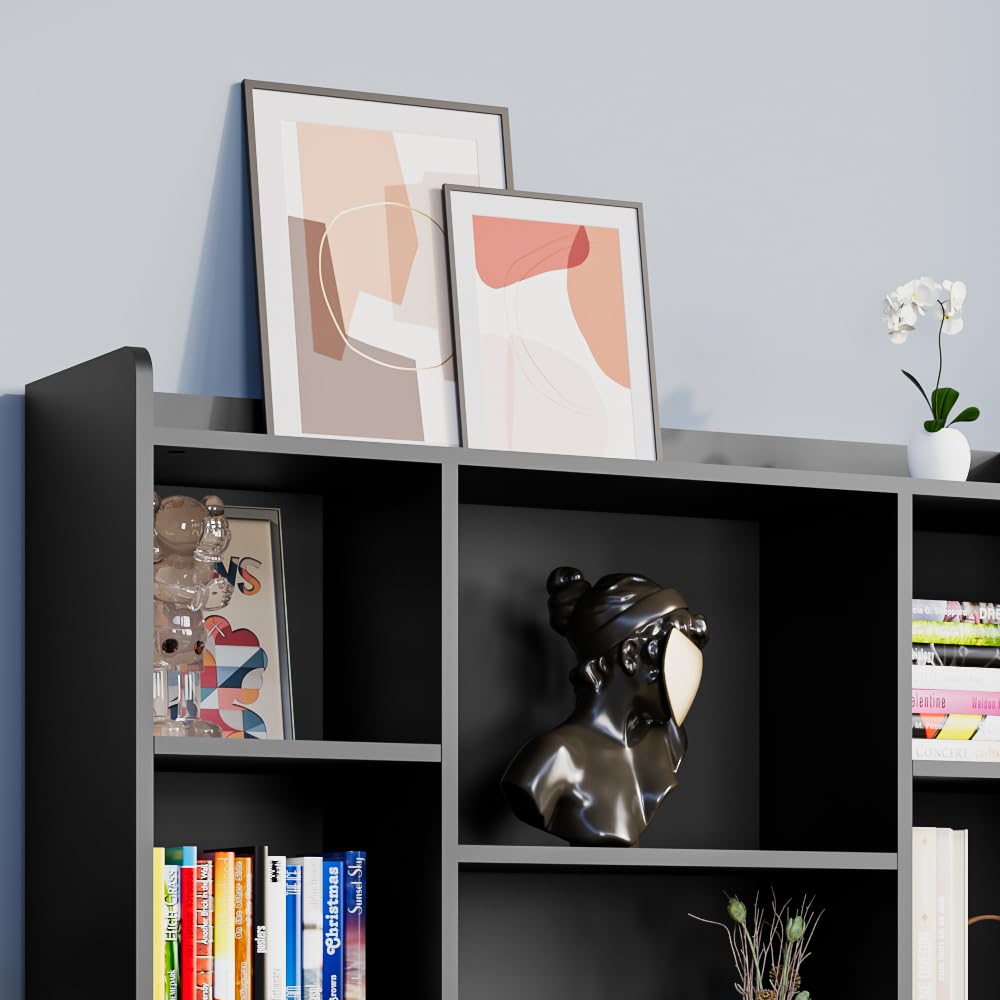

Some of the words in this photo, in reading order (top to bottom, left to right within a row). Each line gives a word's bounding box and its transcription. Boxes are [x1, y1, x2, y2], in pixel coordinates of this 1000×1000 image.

[347, 857, 366, 878] Sky
[164, 871, 178, 906] GRASS
[347, 881, 364, 915] Sunset
[200, 899, 209, 917] Brick
[325, 867, 342, 956] Christmas
[200, 917, 209, 945] Another
[235, 927, 243, 939] On
